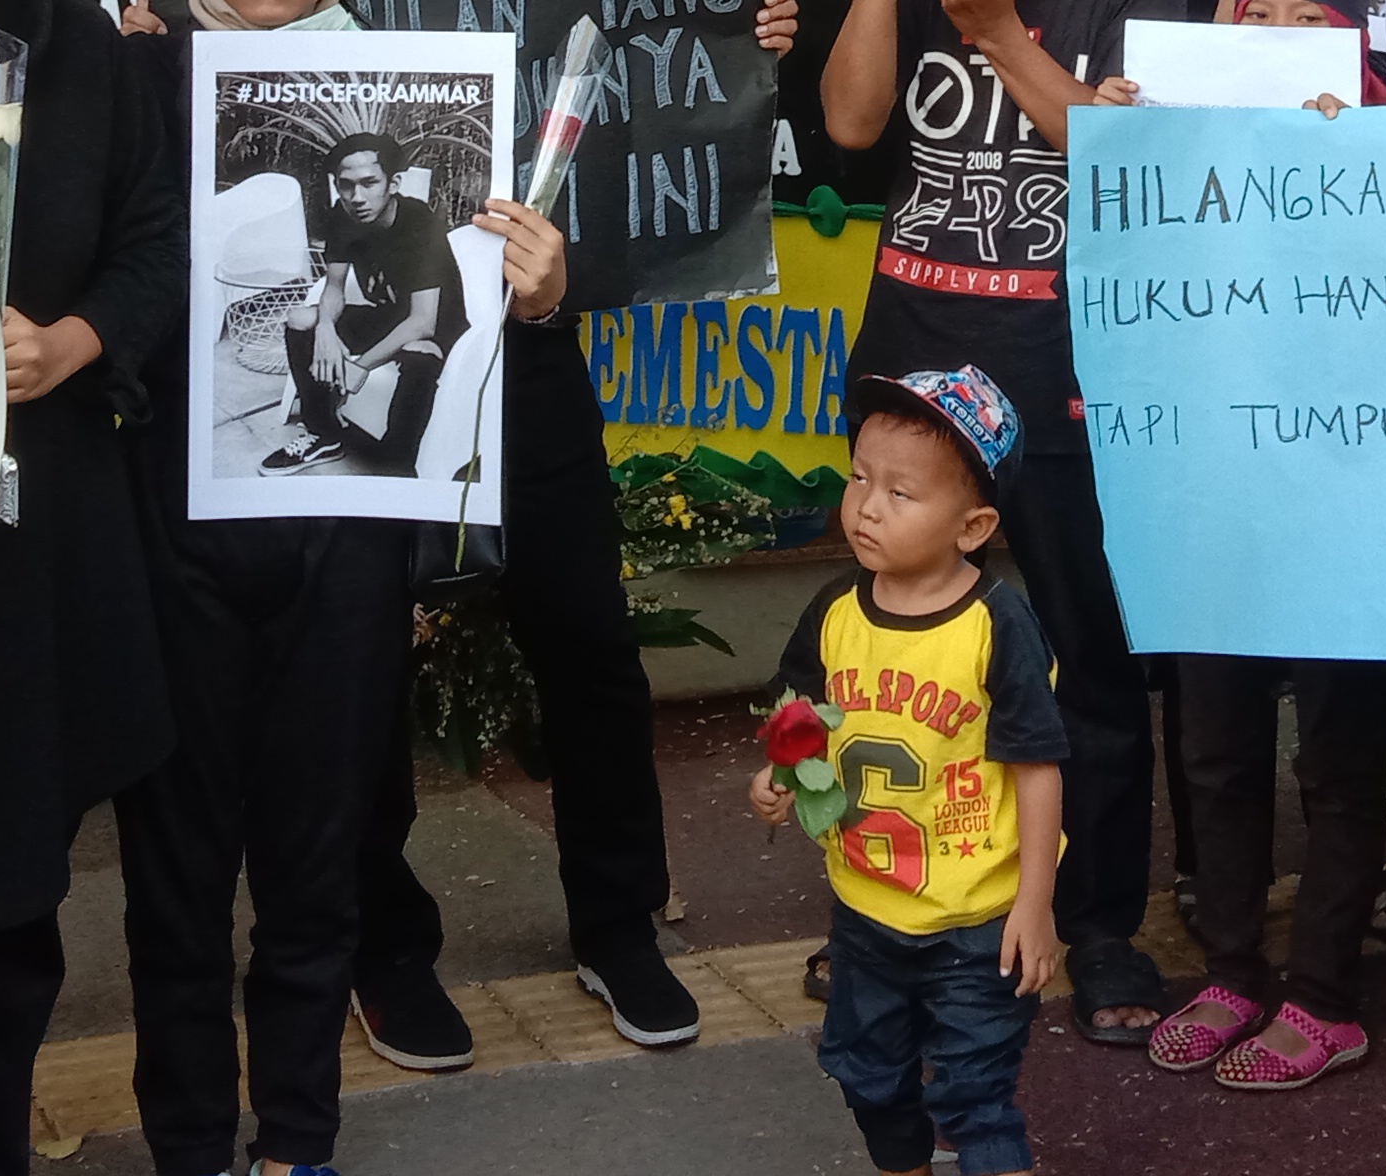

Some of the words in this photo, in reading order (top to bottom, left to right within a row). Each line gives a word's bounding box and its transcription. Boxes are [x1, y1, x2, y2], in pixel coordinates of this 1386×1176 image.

[237, 82, 482, 105] #JUSTICEFORAMMAR
[966, 151, 1003, 171] 2008
[893, 258, 979, 290] SUPPLY
[1083, 275, 1269, 332] HUKUM
[1086, 403, 1180, 448] TAPI
[876, 668, 983, 740] SPORT
[835, 734, 930, 898] 6
[933, 795, 991, 821] LONDON
[934, 814, 991, 837] LEAGUE
